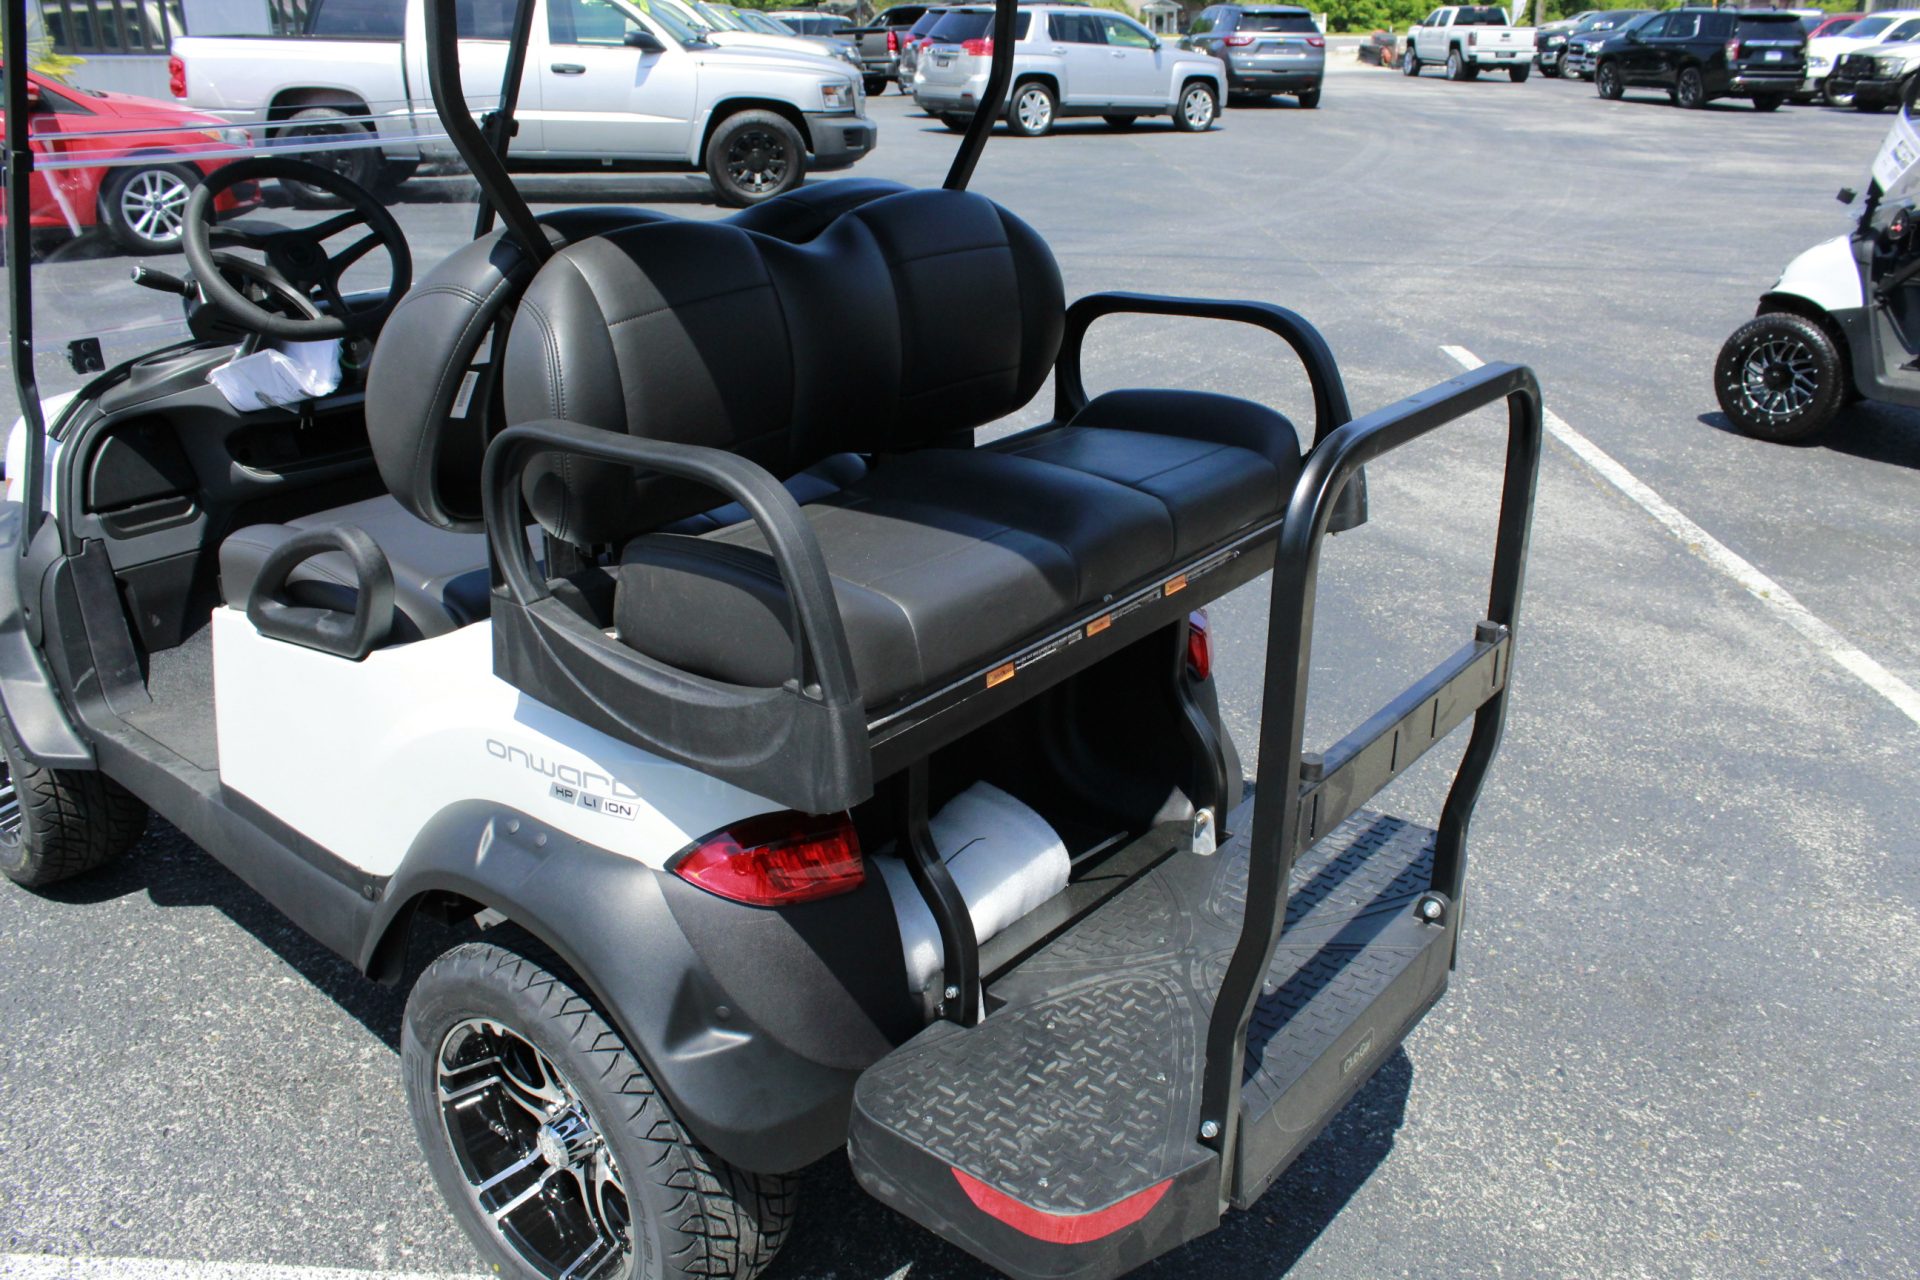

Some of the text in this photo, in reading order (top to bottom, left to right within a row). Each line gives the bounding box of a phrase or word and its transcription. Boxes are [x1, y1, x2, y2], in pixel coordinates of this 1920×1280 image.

[555, 786, 632, 816] HP LI ION
